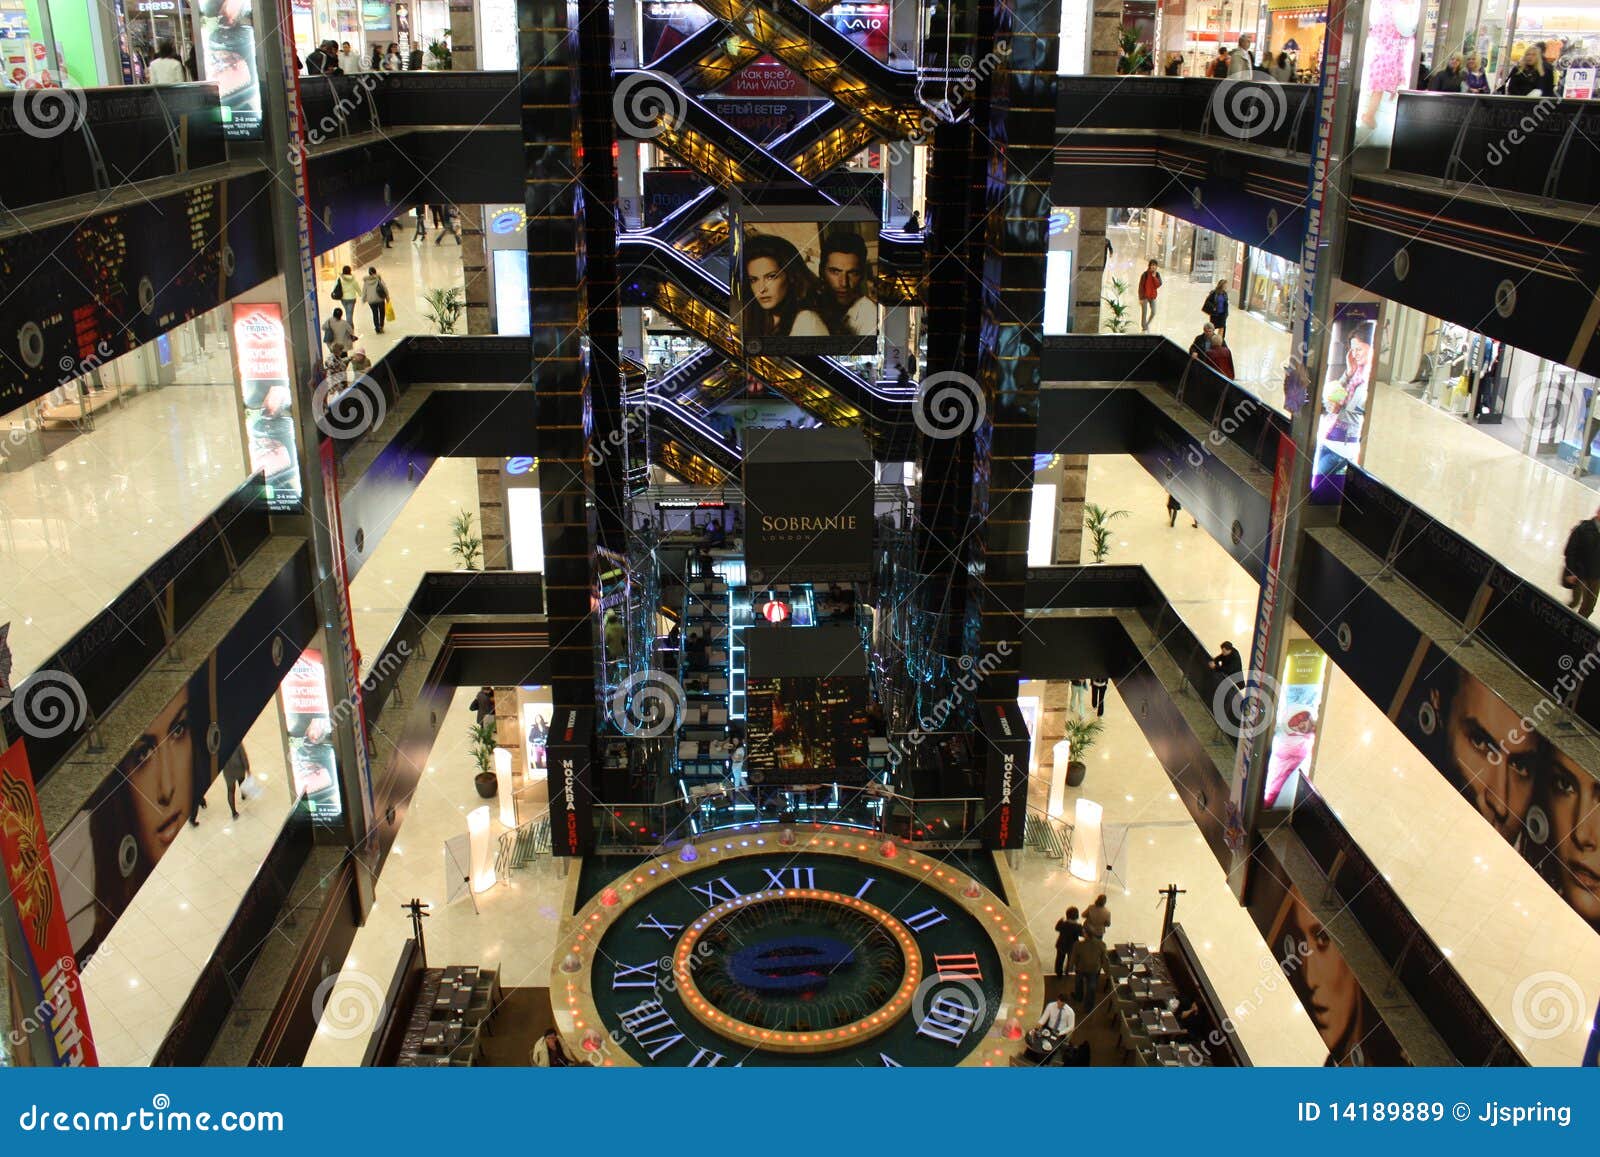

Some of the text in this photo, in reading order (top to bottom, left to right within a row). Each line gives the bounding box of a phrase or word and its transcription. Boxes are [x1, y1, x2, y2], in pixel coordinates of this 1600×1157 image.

[843, 19, 881, 29] VAIO
[737, 79, 795, 90] Или VAIO?
[741, 70, 792, 80] Как все?
[717, 102, 788, 116] БЕЛЫЙ ВЕТЕР
[762, 516, 857, 531] SOBRANIE
[567, 812, 578, 854] SUSHI
[691, 875, 744, 908] XI
[762, 867, 815, 891] XII
[636, 912, 685, 939] X
[900, 905, 950, 933] II
[612, 959, 659, 991] IX
[932, 951, 984, 982] III
[616, 1000, 685, 1061] VIII
